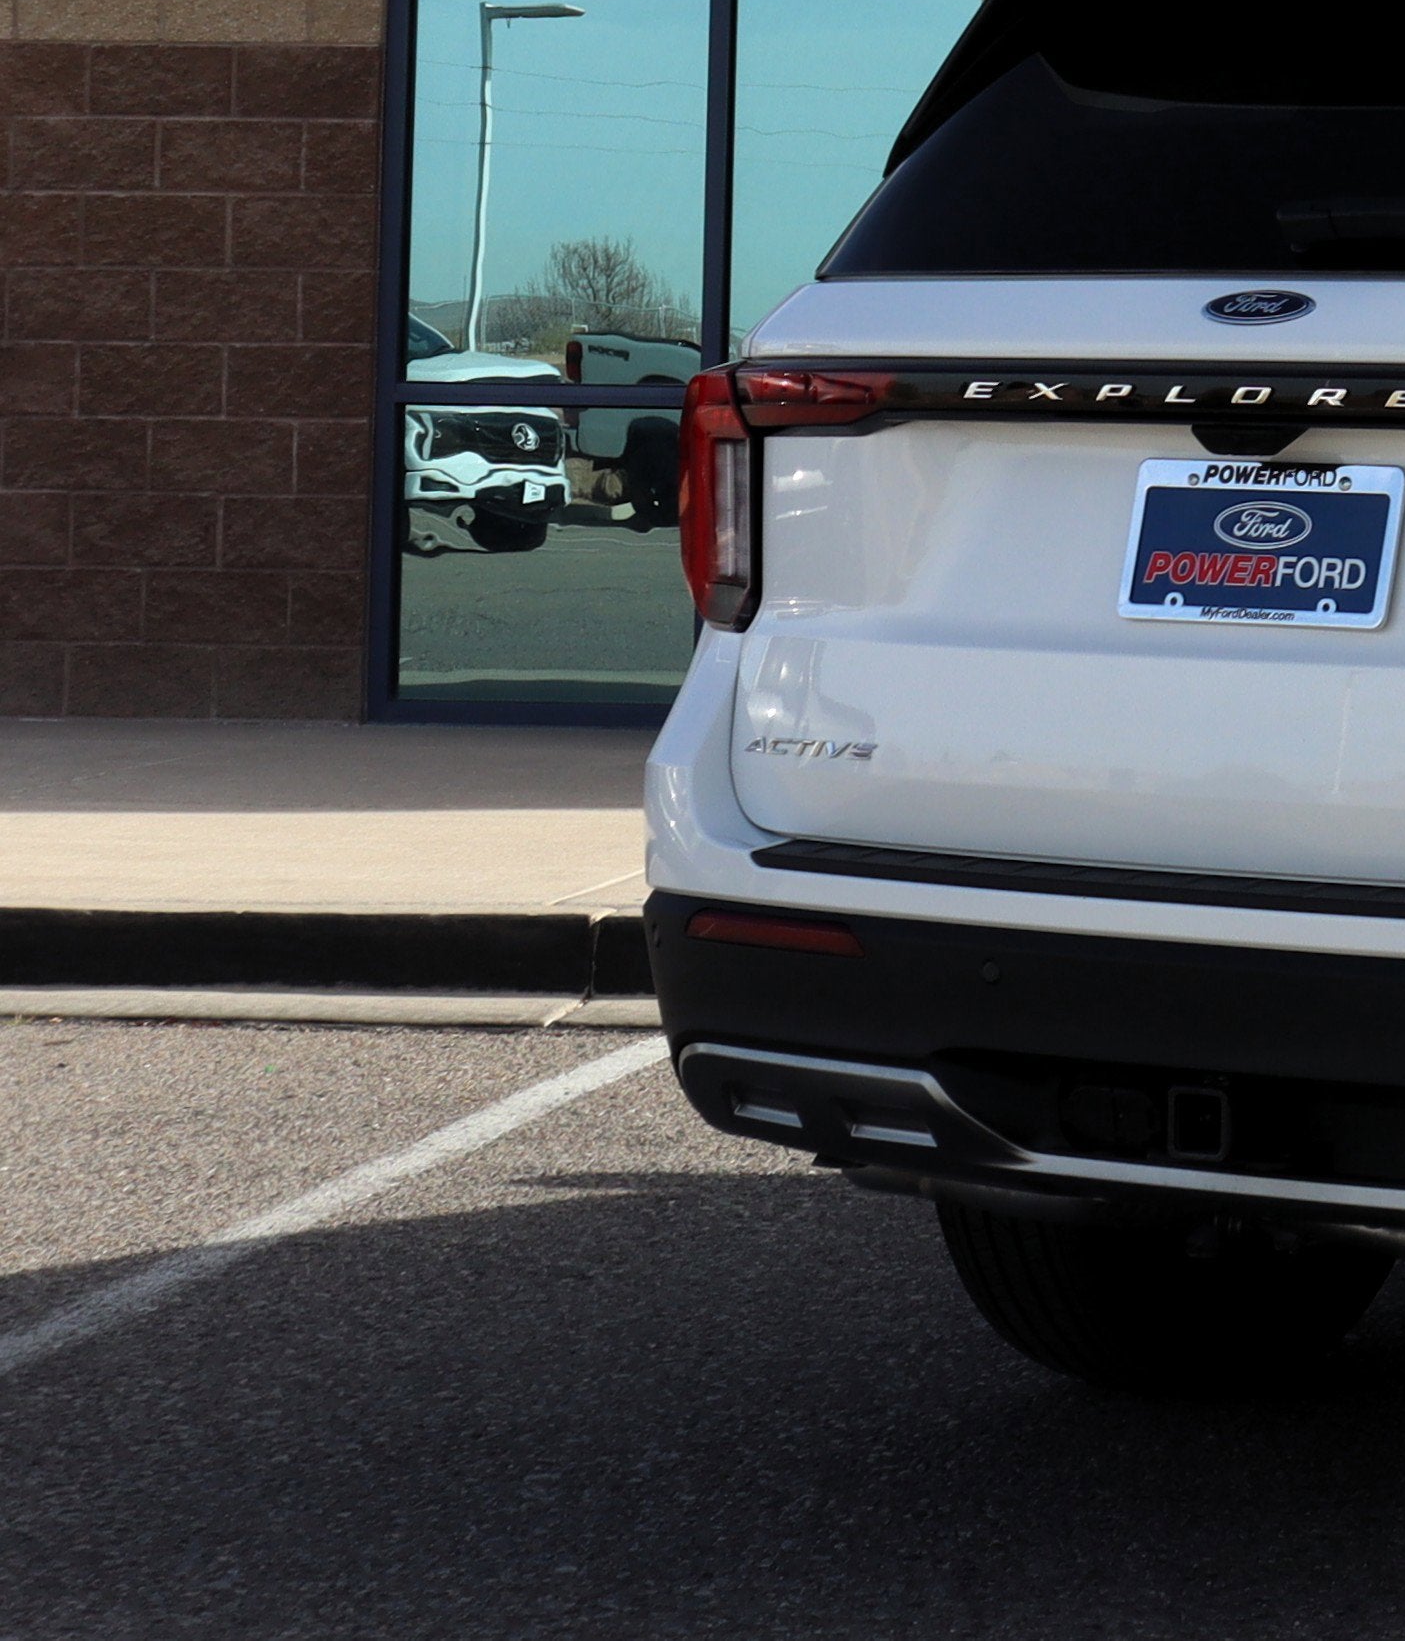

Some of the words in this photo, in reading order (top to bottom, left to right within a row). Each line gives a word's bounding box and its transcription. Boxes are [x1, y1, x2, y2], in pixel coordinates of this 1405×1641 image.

[1223, 294, 1289, 314] Ford
[1233, 510, 1293, 539] Ford
[1143, 551, 1366, 590] POWERFORD
[1200, 606, 1295, 623] MyFordDealer.com
[744, 737, 878, 761] ACTIVE
